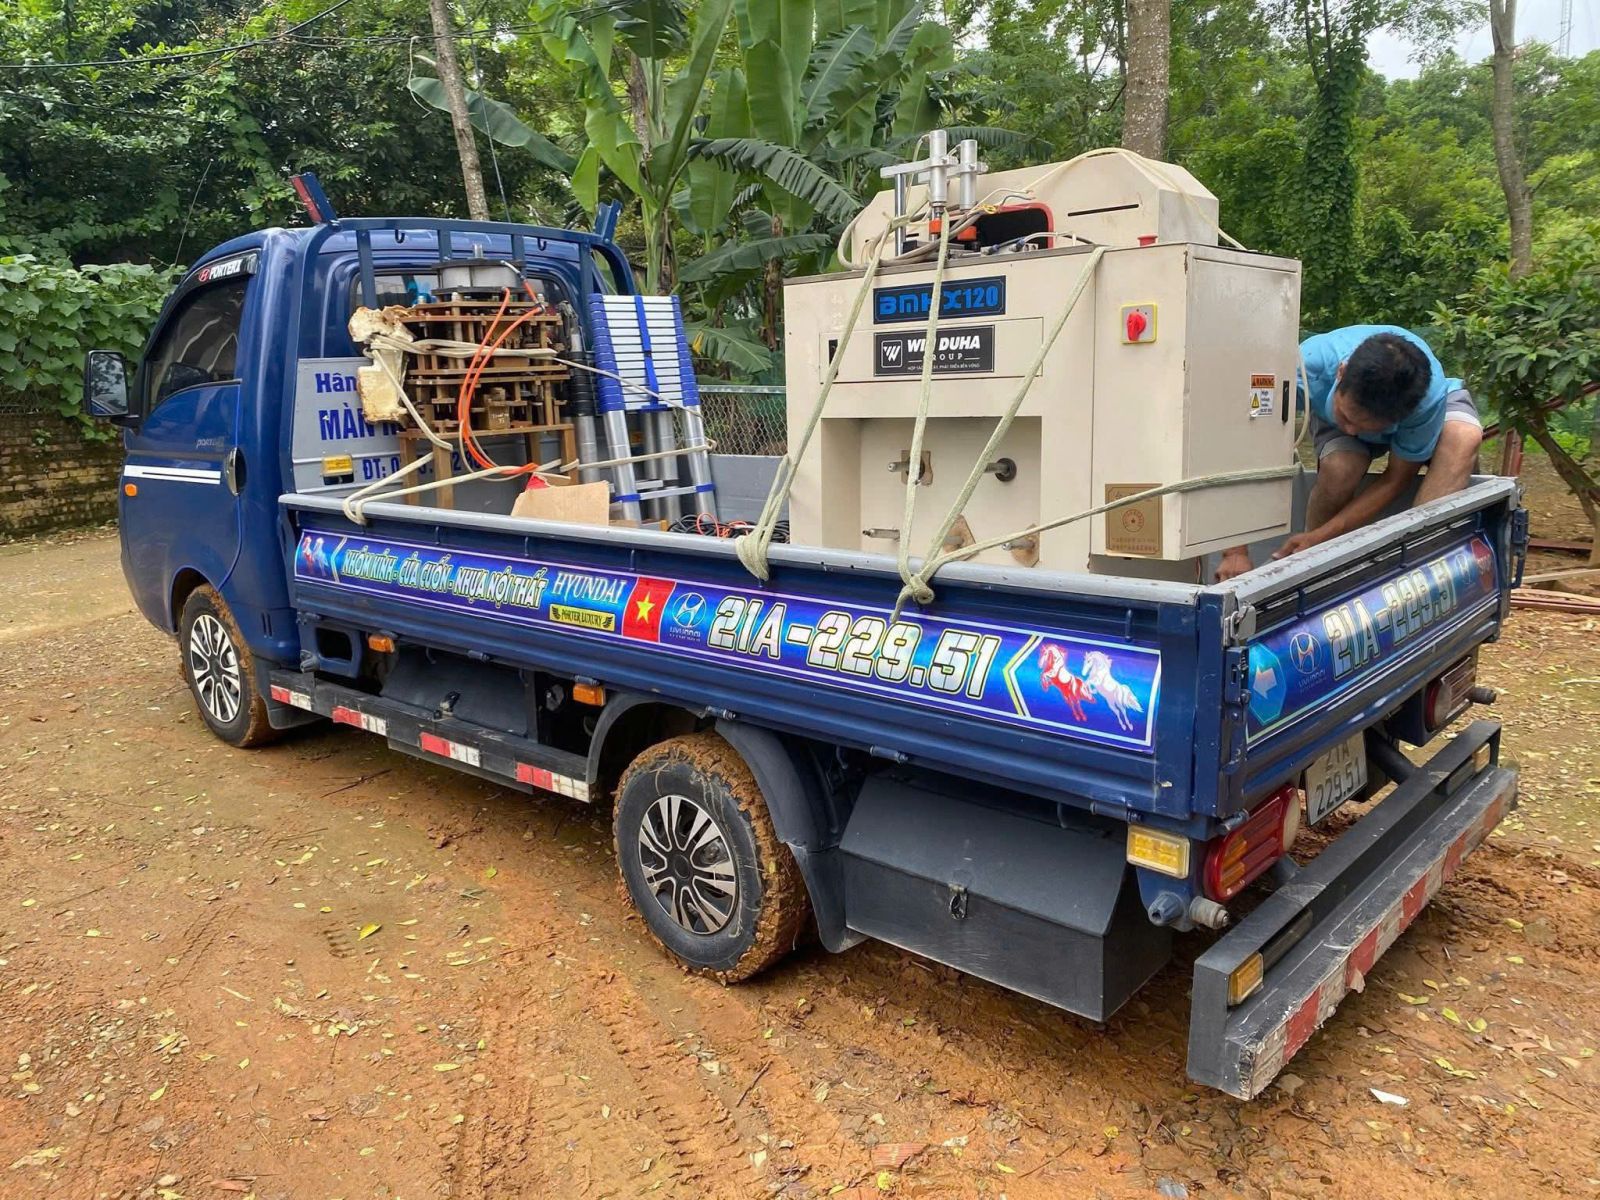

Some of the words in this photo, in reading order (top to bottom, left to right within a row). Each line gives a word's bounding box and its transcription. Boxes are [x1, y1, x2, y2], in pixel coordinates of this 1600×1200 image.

[939, 335, 980, 350] DUHA
[930, 353, 963, 361] ROUP
[552, 571, 628, 605] HYUNDAI
[561, 609, 581, 623] PORTER
[581, 612, 603, 627] LUXURY
[707, 596, 1002, 700] 21A-229.51
[1315, 756, 1361, 816] 229.51
